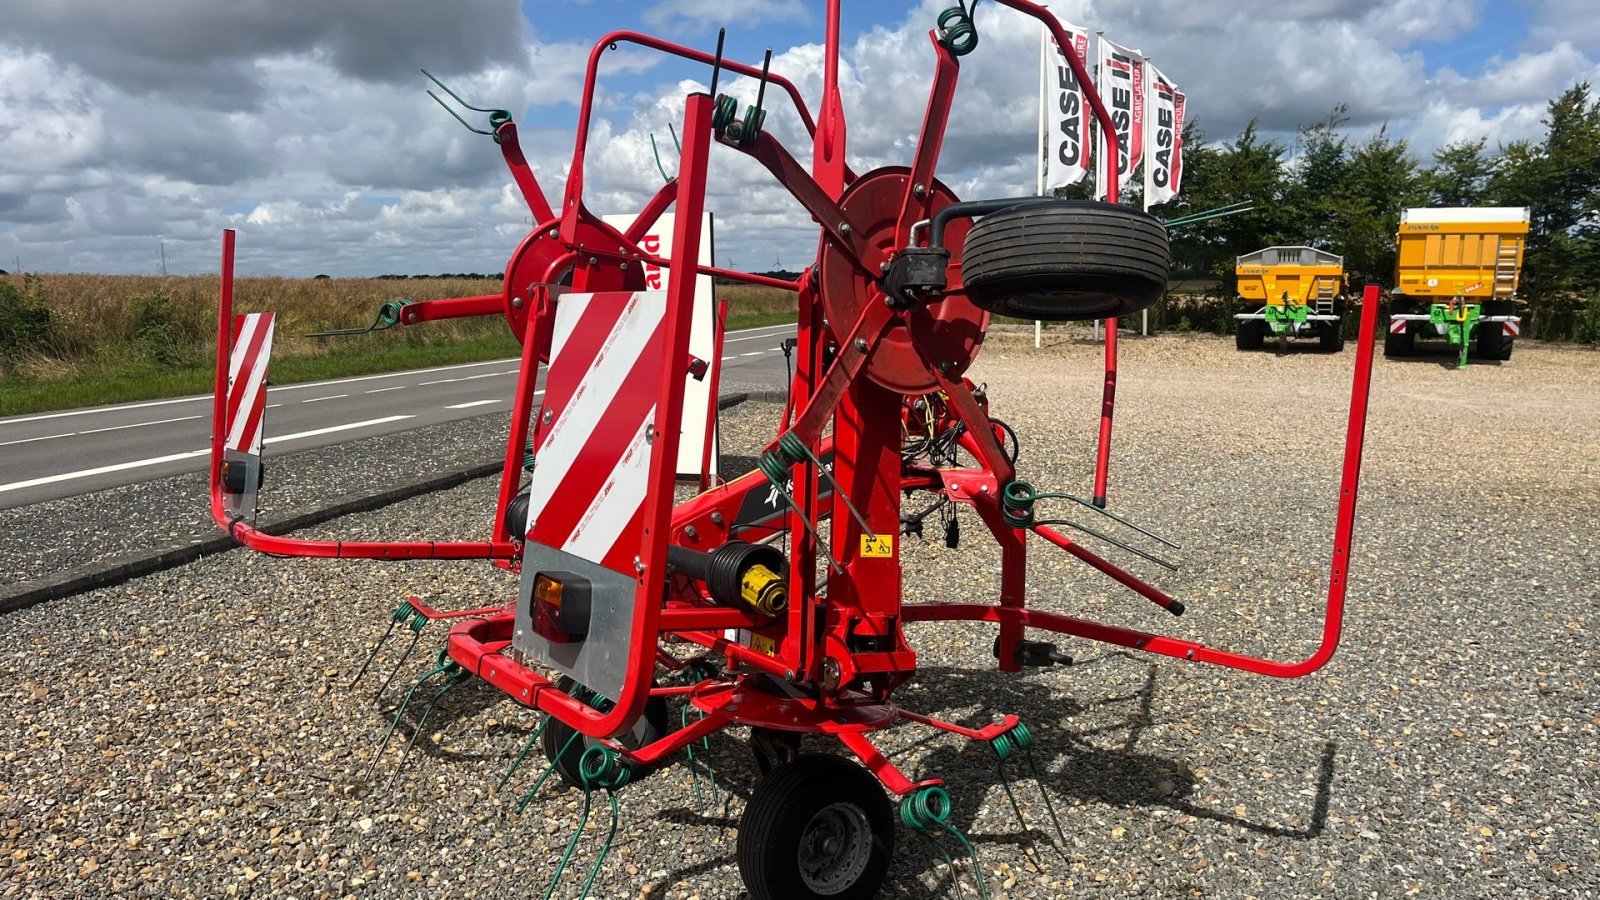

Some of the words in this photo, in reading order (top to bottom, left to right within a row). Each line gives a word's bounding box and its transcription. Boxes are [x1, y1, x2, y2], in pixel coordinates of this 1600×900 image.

[1058, 65, 1080, 167] CASE
[1132, 61, 1143, 125] AGRICULTURE
[1174, 92, 1186, 141] AGRICULTU
[1153, 107, 1173, 188] CASE
